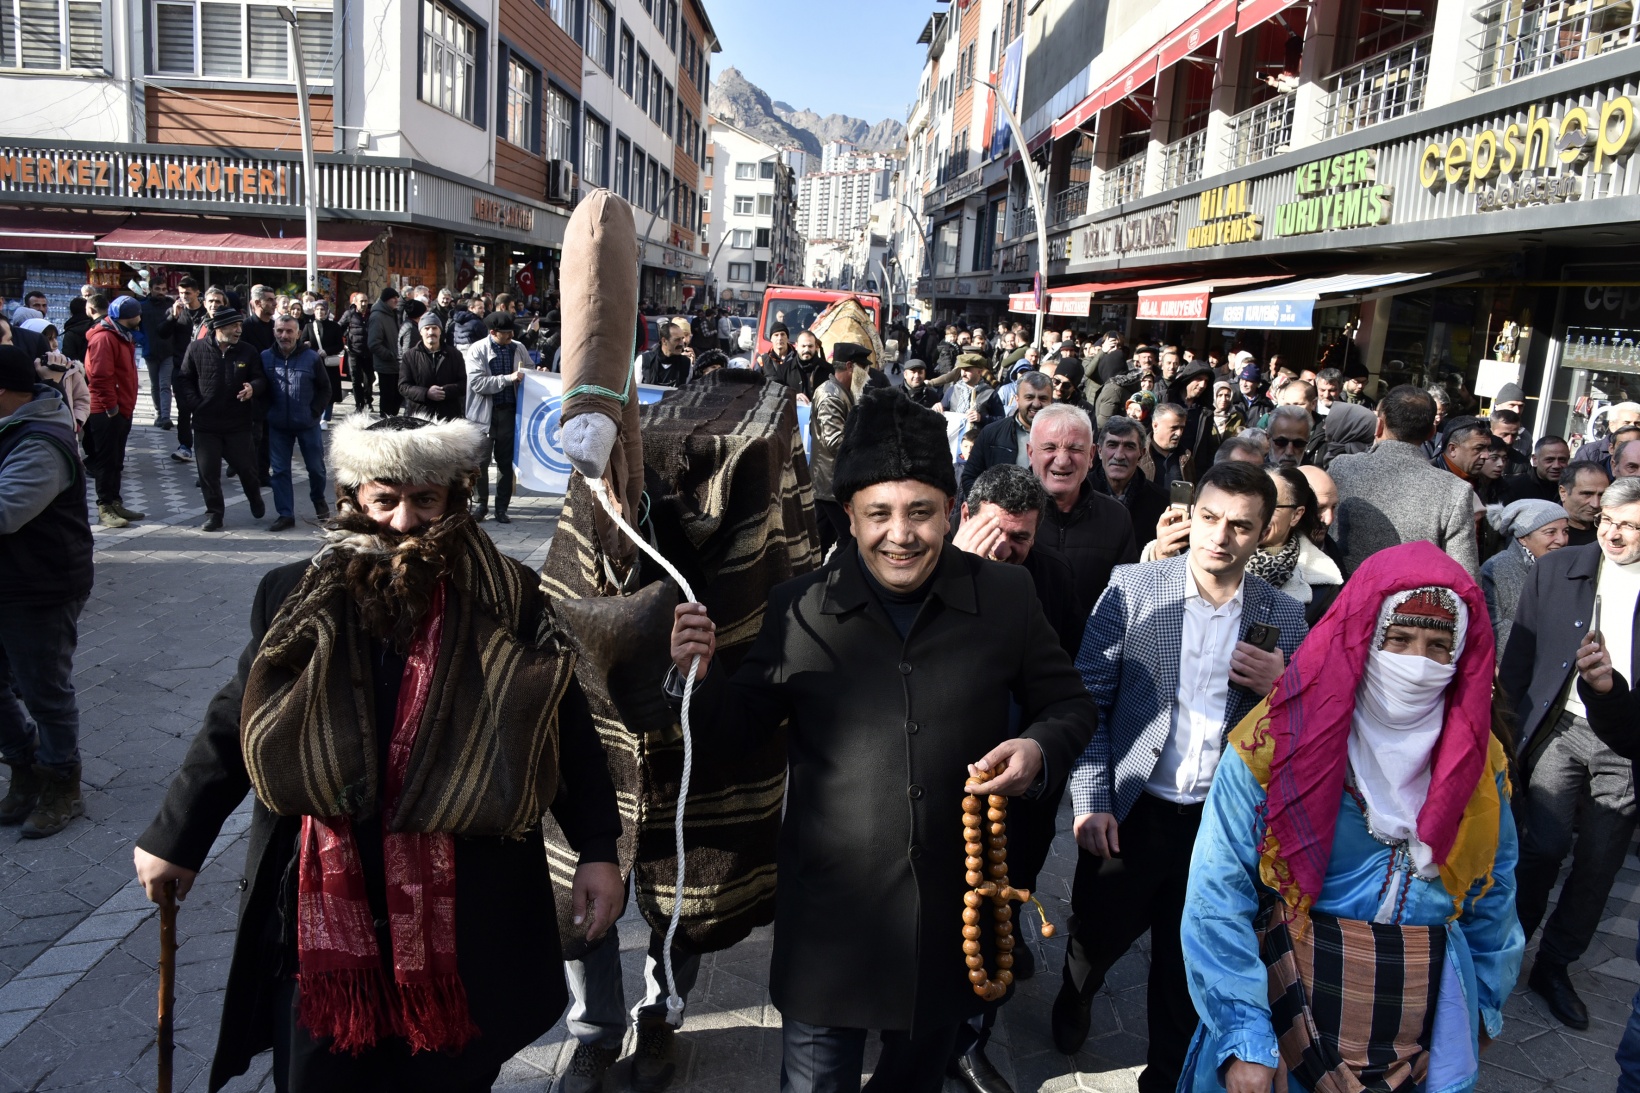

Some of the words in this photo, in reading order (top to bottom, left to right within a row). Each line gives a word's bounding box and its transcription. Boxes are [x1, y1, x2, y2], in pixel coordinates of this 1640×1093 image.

[1420, 96, 1633, 194] cepshop
[0, 155, 109, 187] MERKEZ
[128, 160, 286, 196] ŞARKÜTERİ
[1295, 150, 1369, 195] KEVSER
[1274, 184, 1385, 236] KURUYEMİŞ
